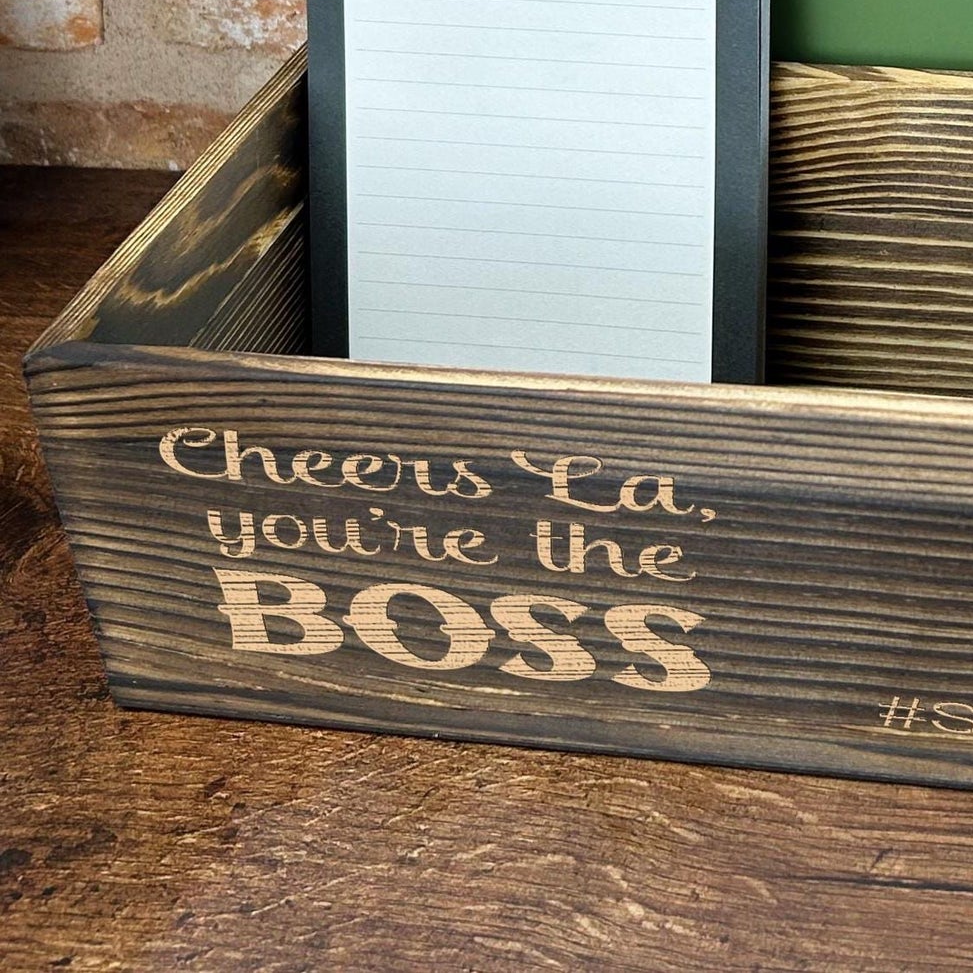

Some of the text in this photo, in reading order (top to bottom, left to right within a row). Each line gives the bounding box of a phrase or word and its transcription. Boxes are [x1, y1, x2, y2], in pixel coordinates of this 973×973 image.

[159, 427, 718, 523] Cheers La,
[206, 507, 698, 581] you're the
[211, 566, 711, 693] BOSS
